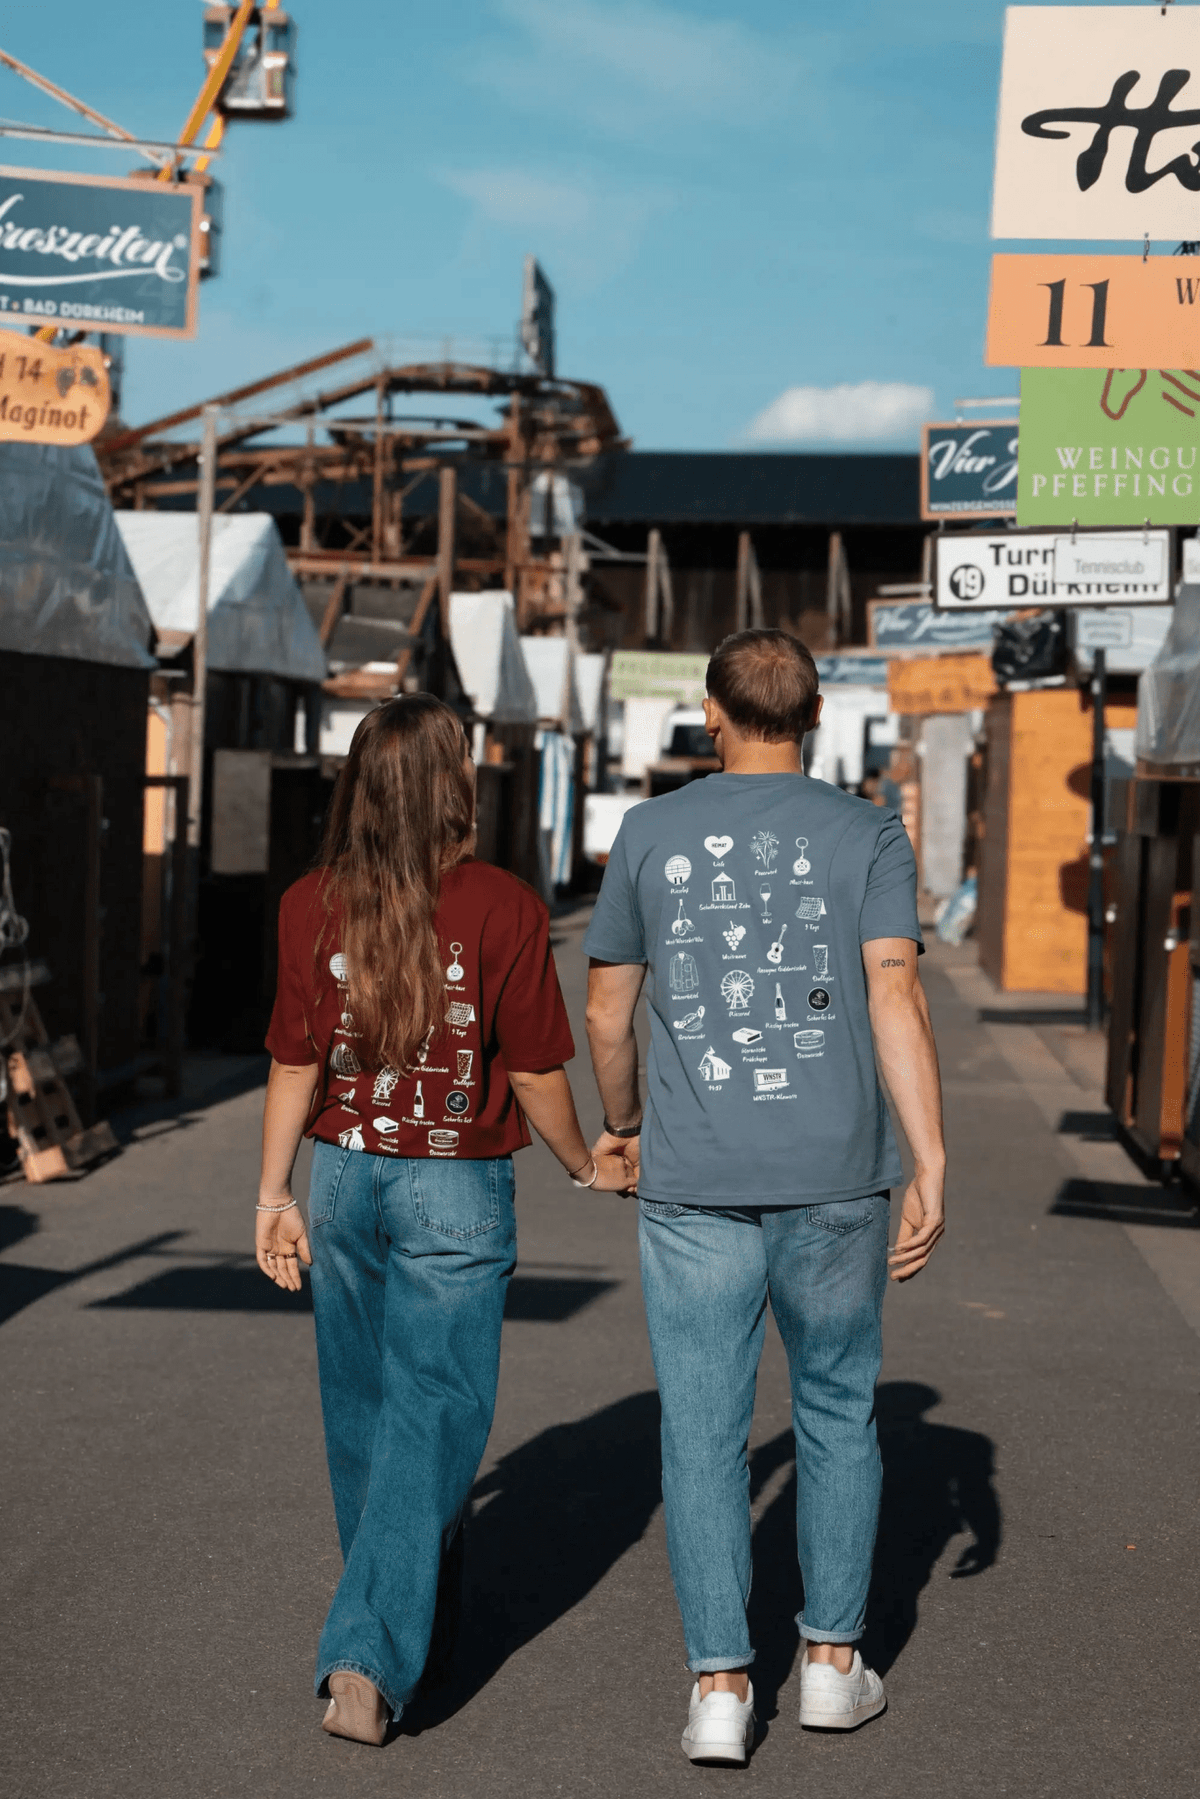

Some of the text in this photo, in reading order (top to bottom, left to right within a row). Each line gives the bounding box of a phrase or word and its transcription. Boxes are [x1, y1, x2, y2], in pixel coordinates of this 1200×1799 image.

[0, 193, 186, 283] reszeiten
[23, 297, 58, 315] BAD
[1035, 278, 1115, 348] 11
[15, 355, 44, 383] 14
[0, 394, 91, 431] aginot
[929, 430, 997, 480] Vier
[952, 566, 981, 598] 19
[804, 923, 809, 931] 9
